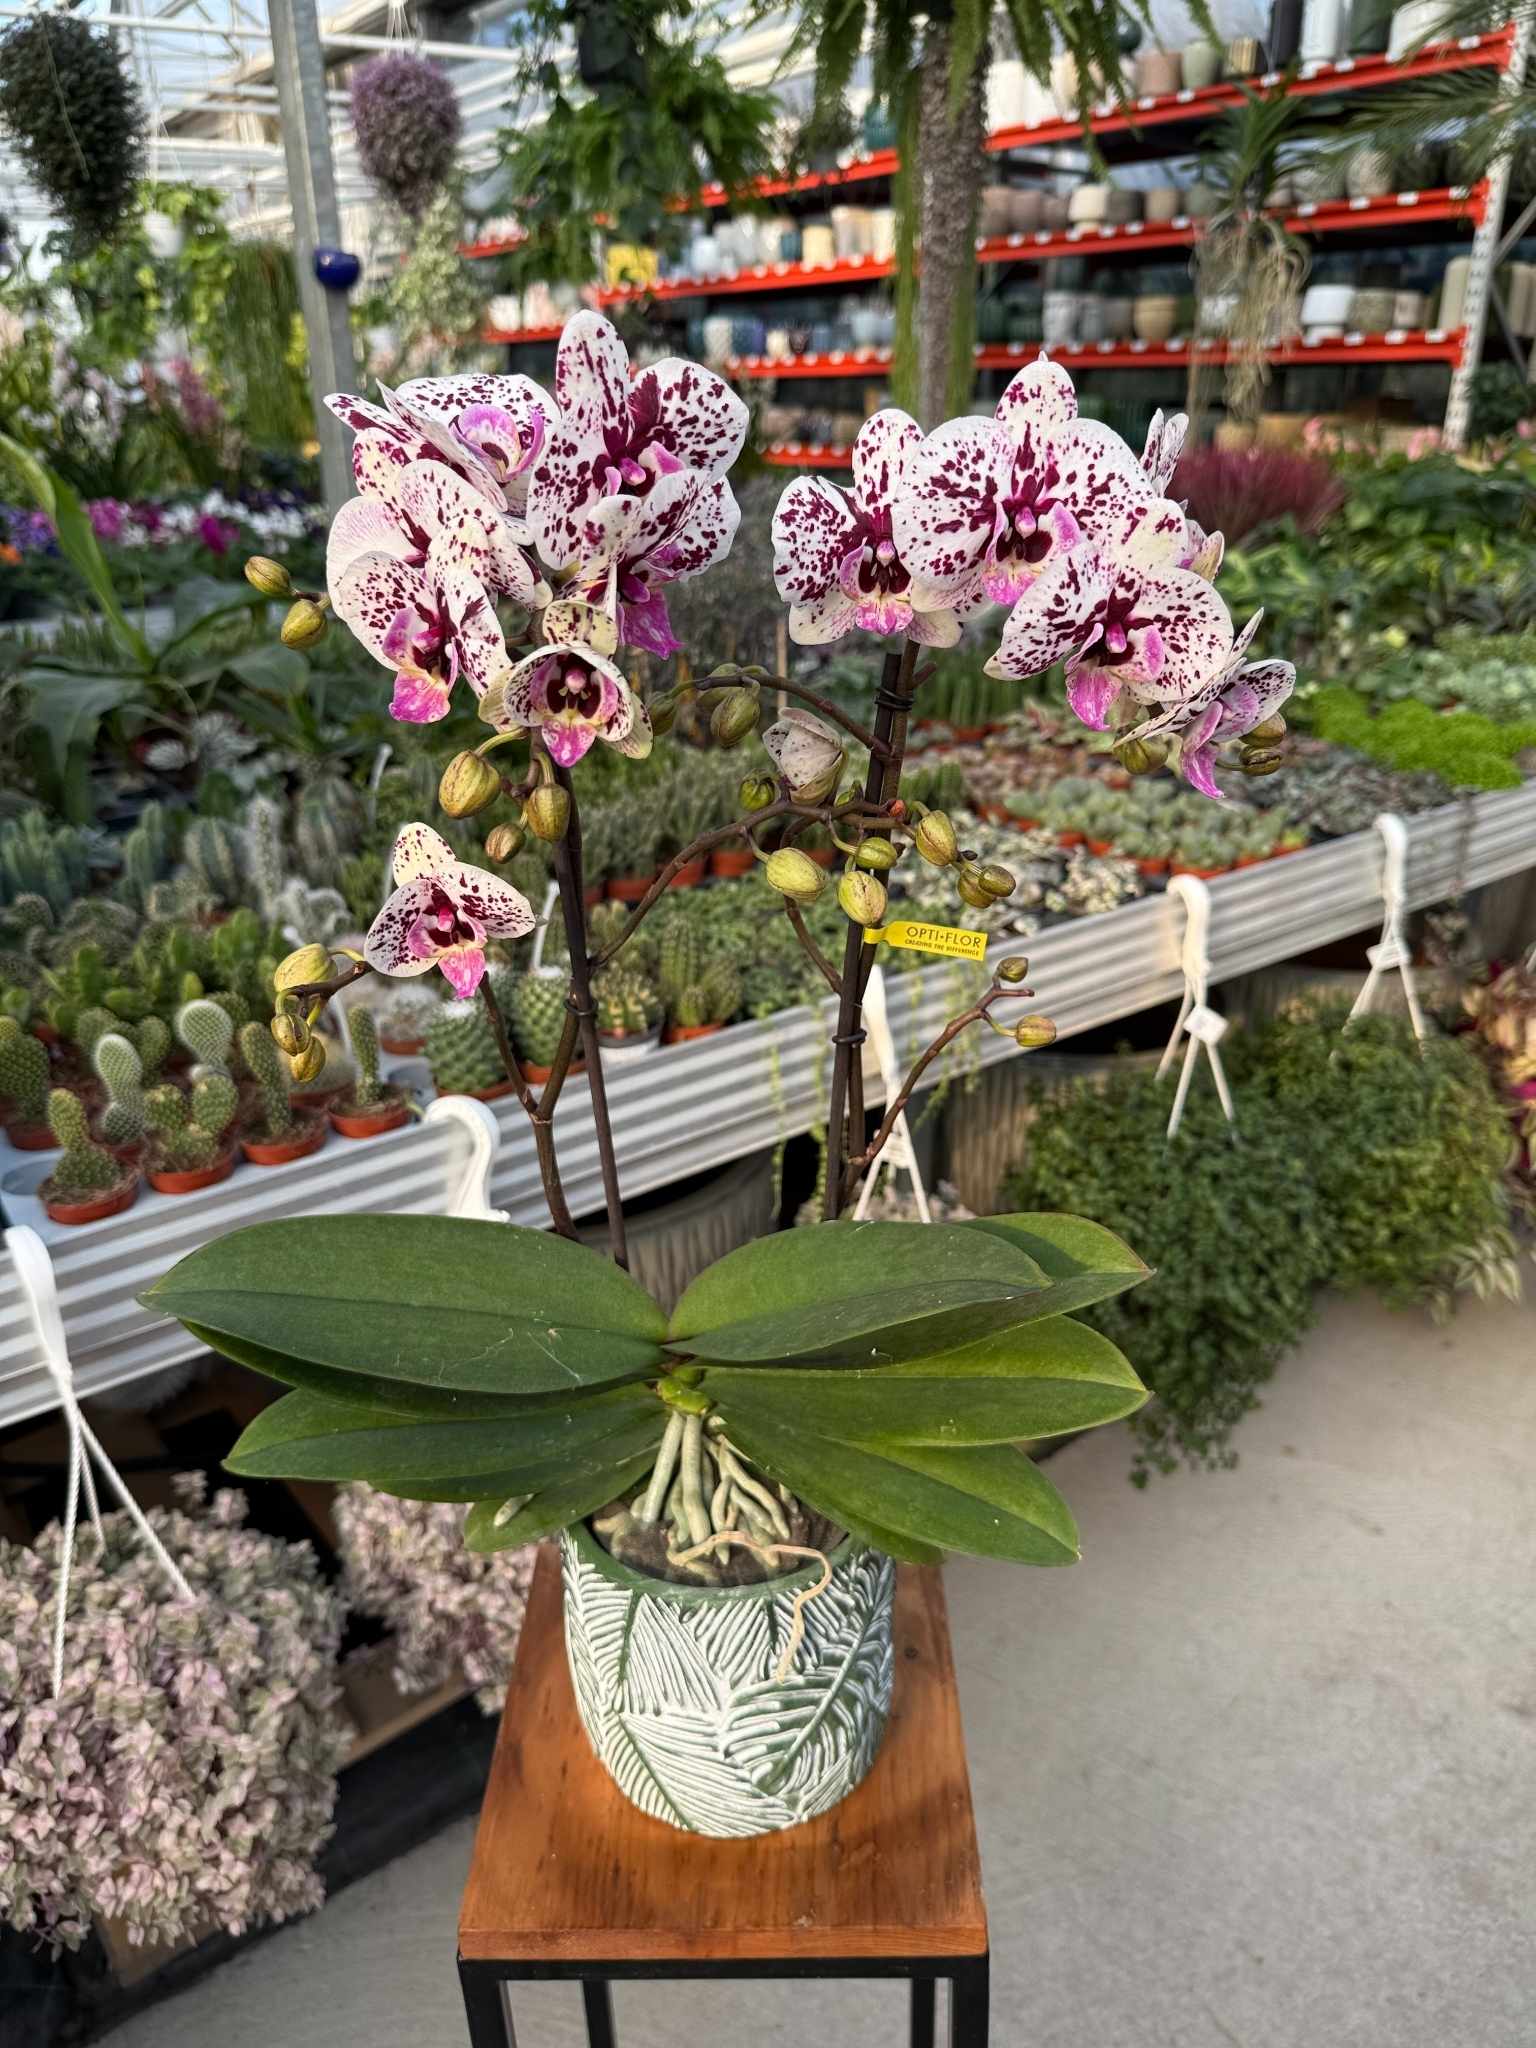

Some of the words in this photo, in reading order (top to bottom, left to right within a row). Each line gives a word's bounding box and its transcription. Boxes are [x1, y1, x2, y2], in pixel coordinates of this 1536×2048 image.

[905, 939, 932, 948] CREATING
[934, 943, 945, 951] THE
[946, 946, 979, 956] DIFFERENCE
